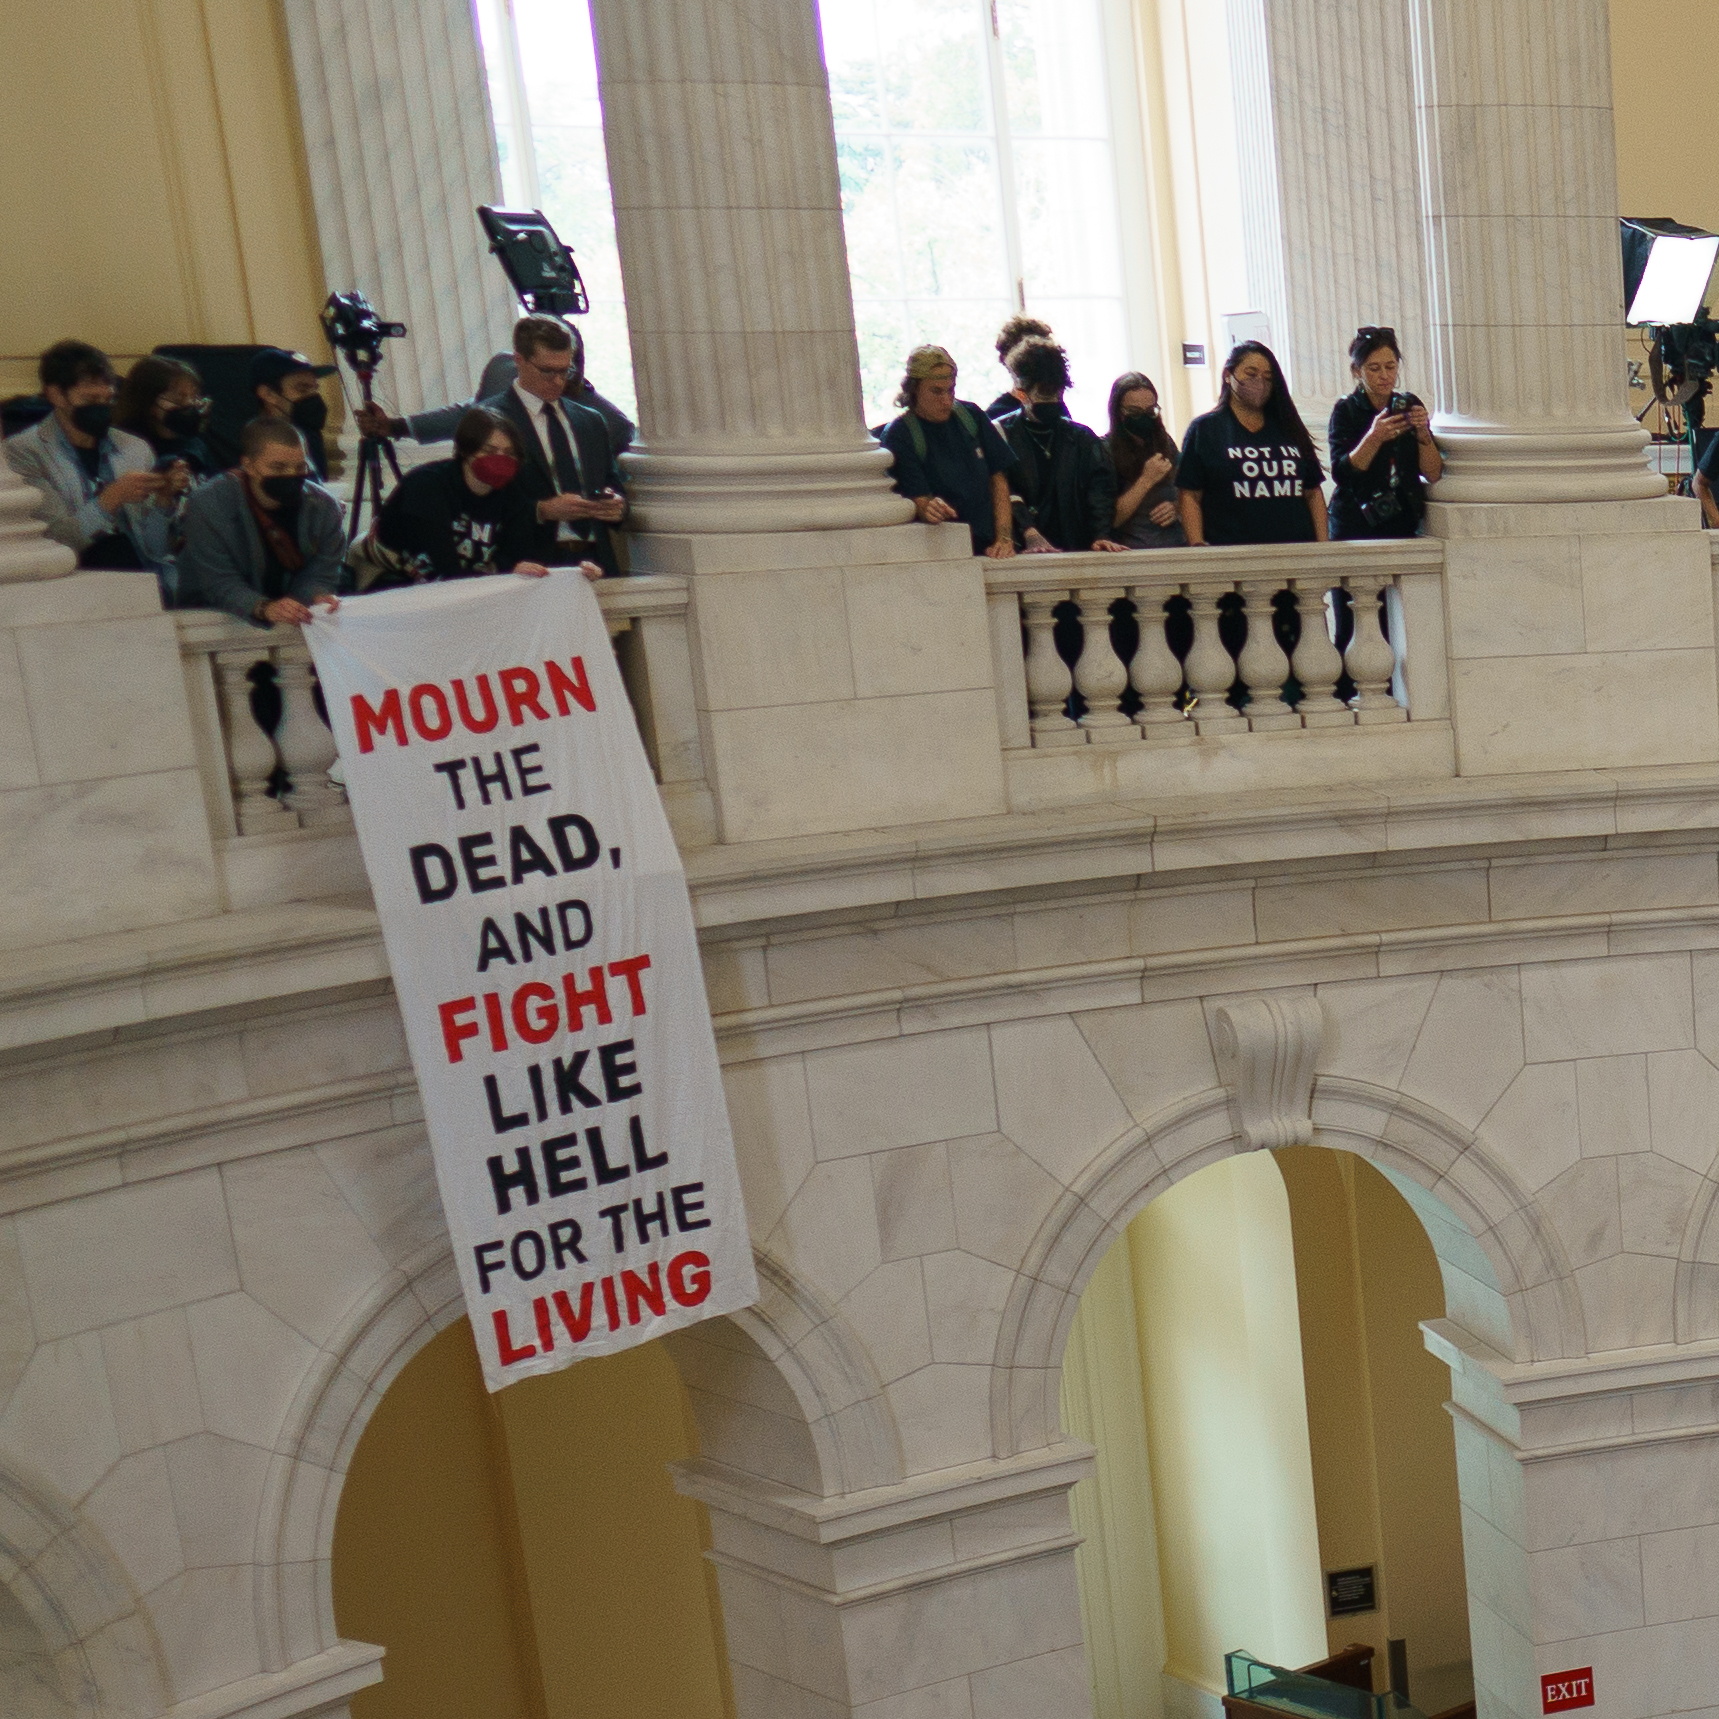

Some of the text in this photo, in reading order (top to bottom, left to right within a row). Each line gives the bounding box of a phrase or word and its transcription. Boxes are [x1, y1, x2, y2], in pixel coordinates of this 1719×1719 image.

[1229, 447, 1270, 459] NOT
[1243, 461, 1297, 477] OUR
[350, 656, 597, 753] MOURN
[434, 743, 553, 809] THE
[409, 813, 622, 904] DEAD,
[477, 900, 594, 971] AND
[438, 955, 652, 1063] FIGHT
[483, 1039, 643, 1134] LIKE
[488, 1117, 668, 1215] HELL
[473, 1182, 712, 1293] FOR THE
[491, 1251, 713, 1365] LIVING
[1545, 1678, 1590, 1702] EXIT
